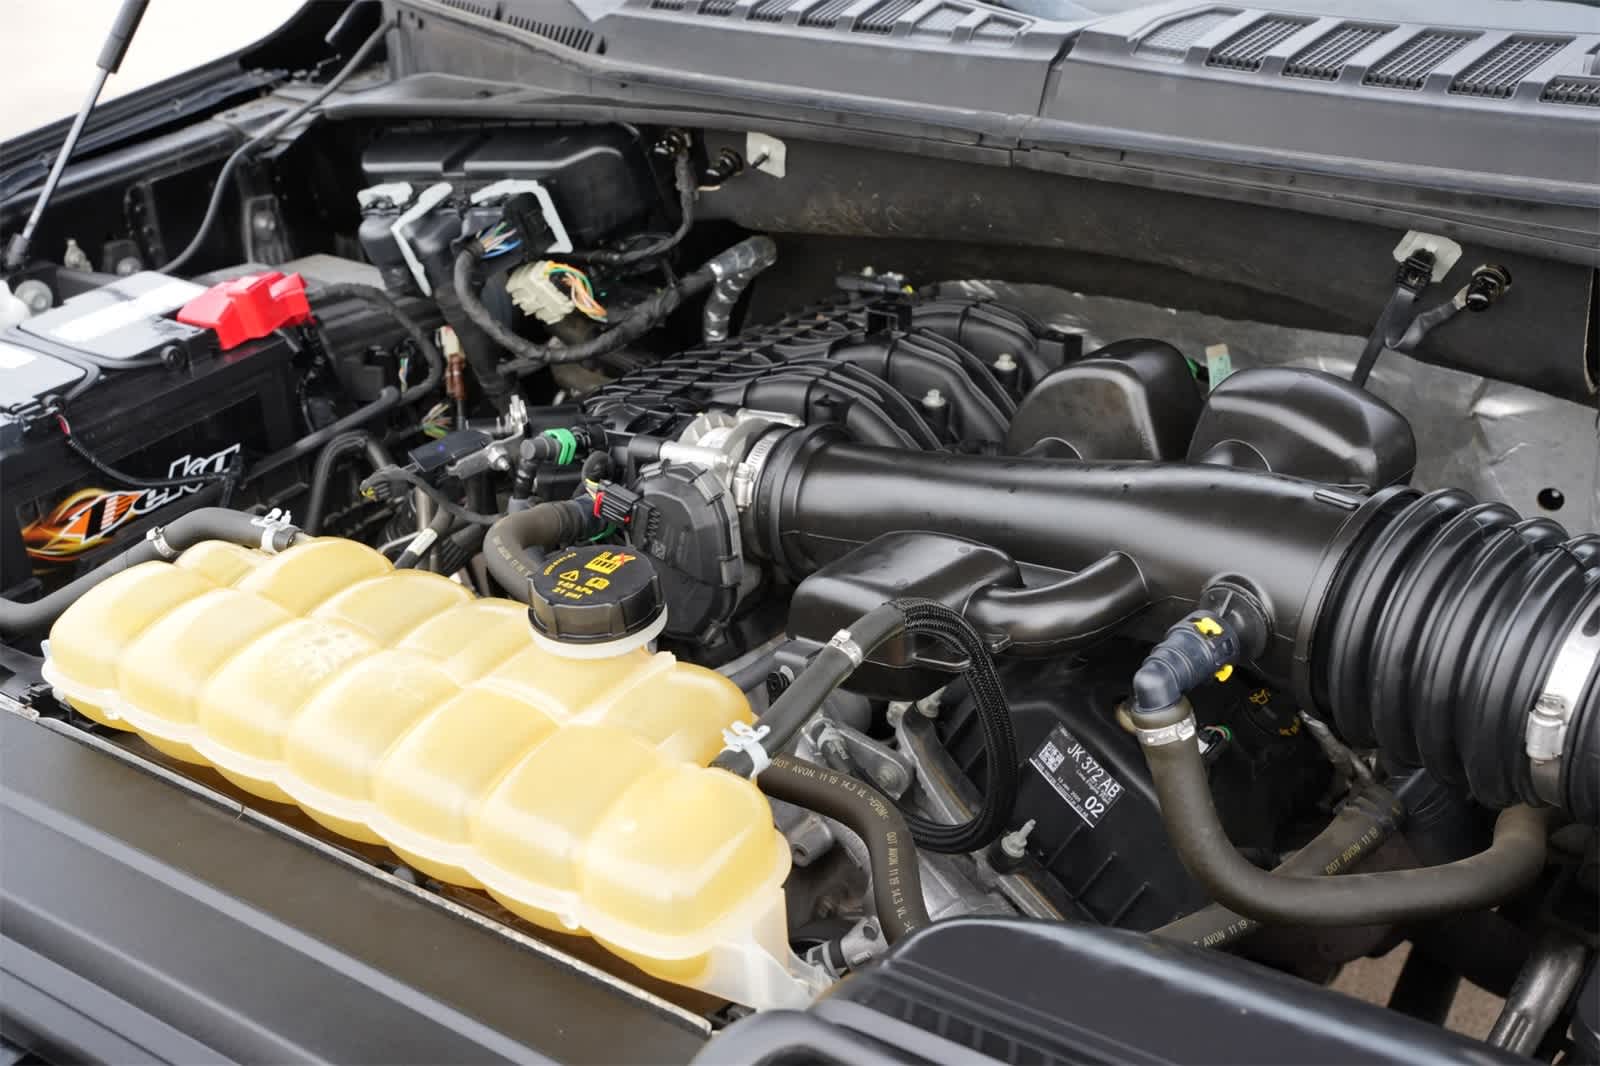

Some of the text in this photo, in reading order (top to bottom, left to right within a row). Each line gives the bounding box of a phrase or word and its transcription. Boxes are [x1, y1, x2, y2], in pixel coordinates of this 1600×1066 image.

[791, 763, 817, 778] AVON
[1067, 743, 1086, 762] JK
[1081, 756, 1104, 782] 372
[1100, 778, 1120, 797] AB
[1084, 795, 1105, 818] 02
[1203, 930, 1225, 947] AVON
